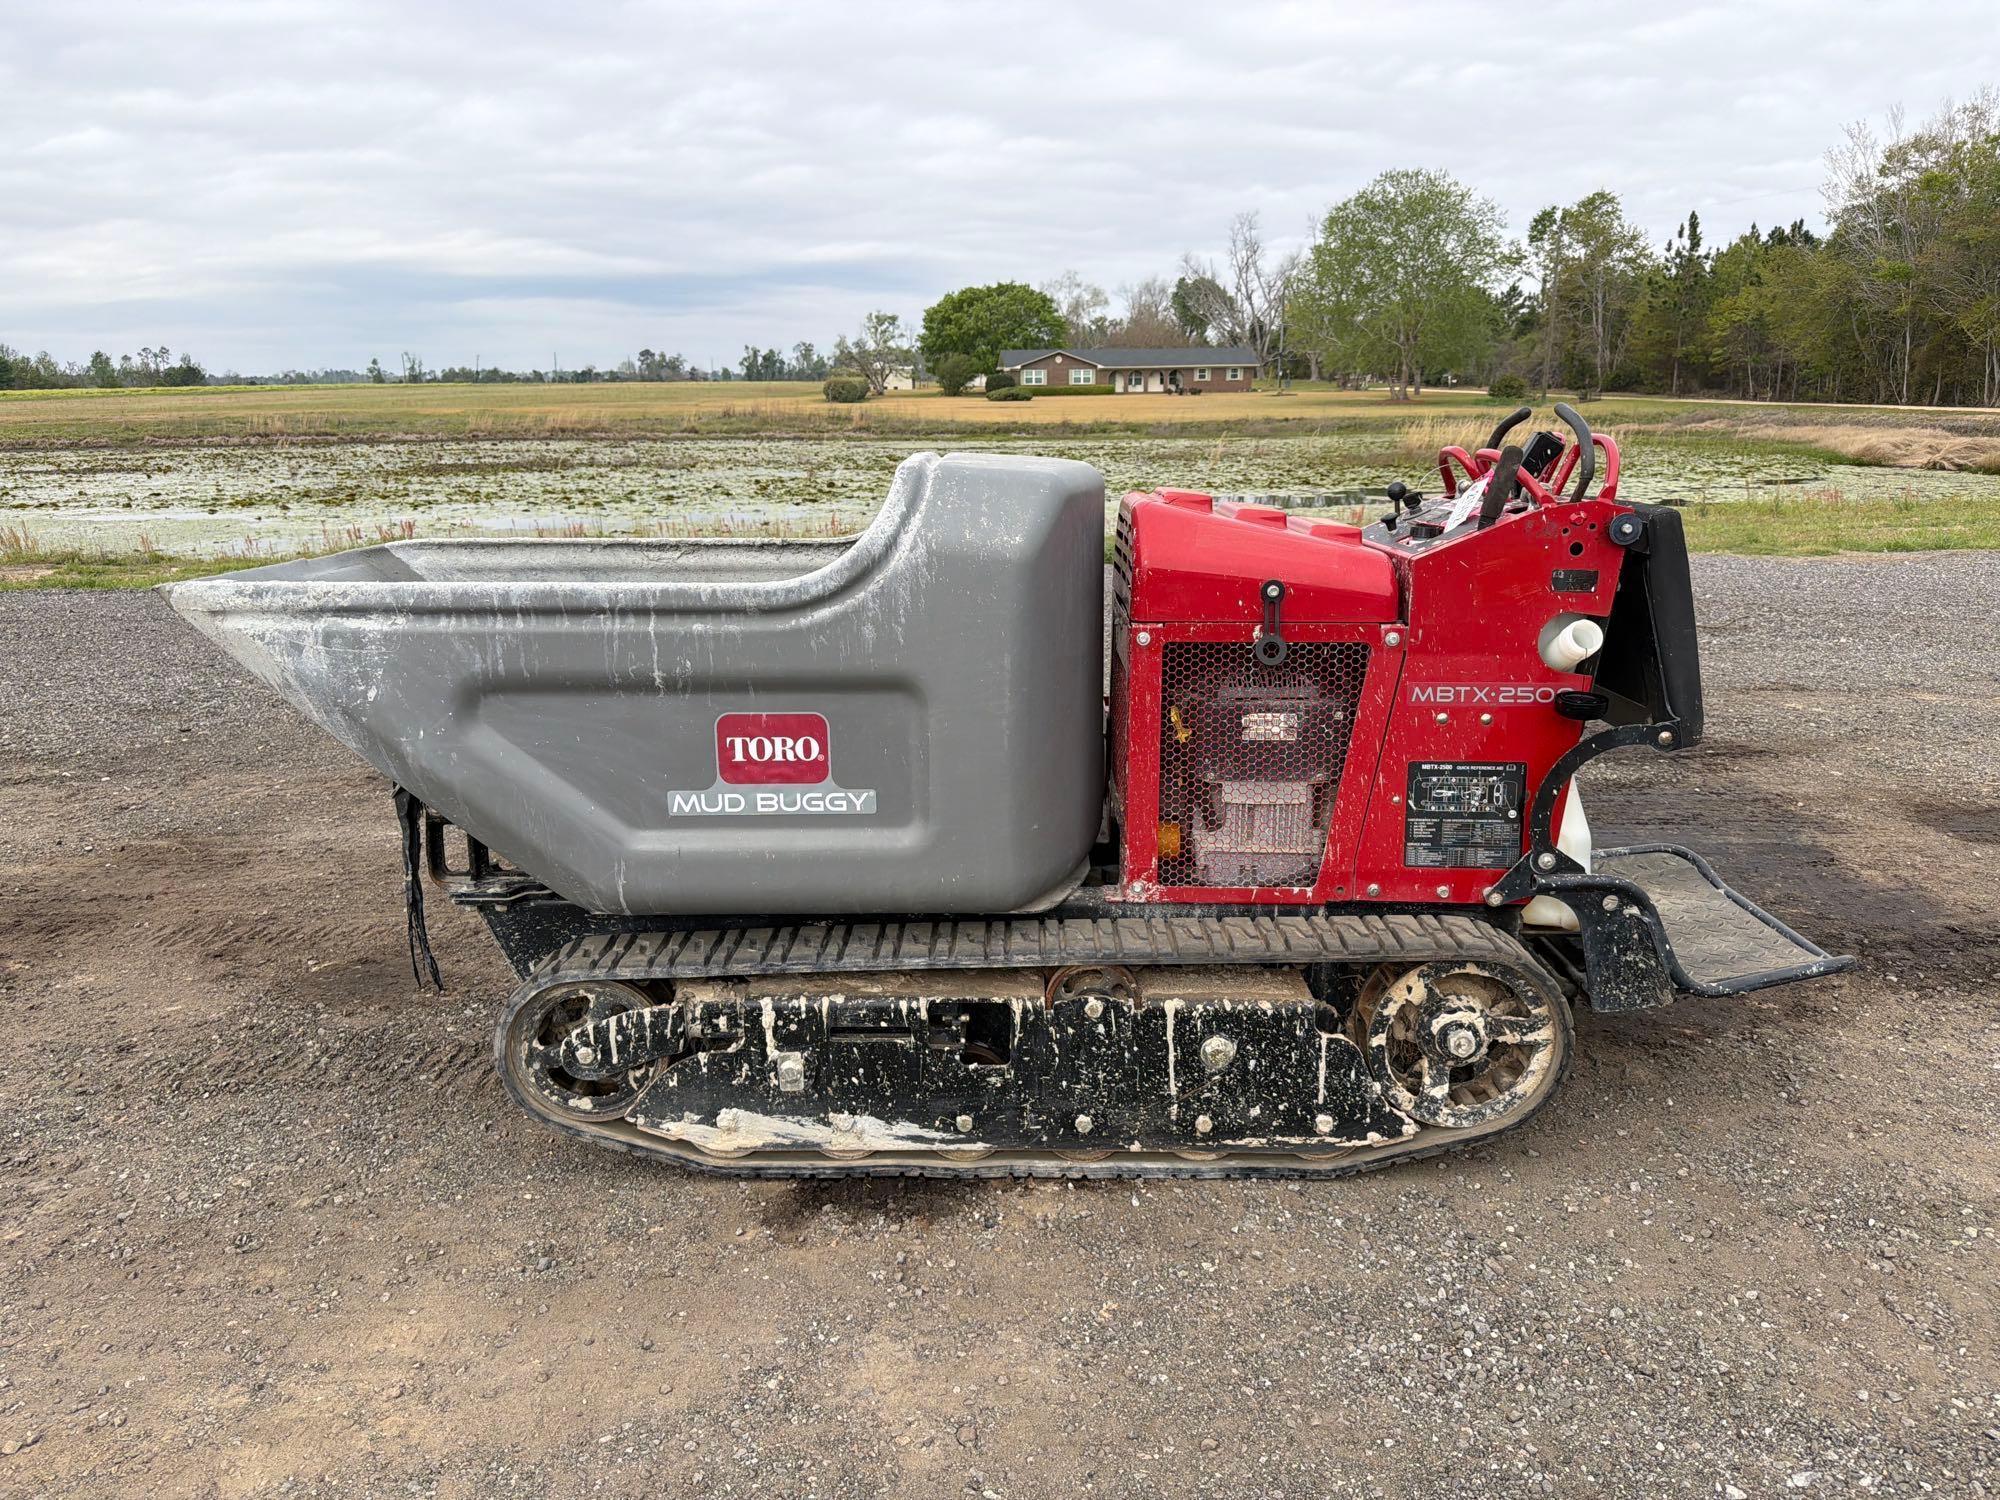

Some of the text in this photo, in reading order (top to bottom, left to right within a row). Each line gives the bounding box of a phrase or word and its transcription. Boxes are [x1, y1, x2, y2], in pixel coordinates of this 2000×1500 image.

[726, 736, 820, 762] TORO
[672, 792, 869, 813] MUD BUGGY
